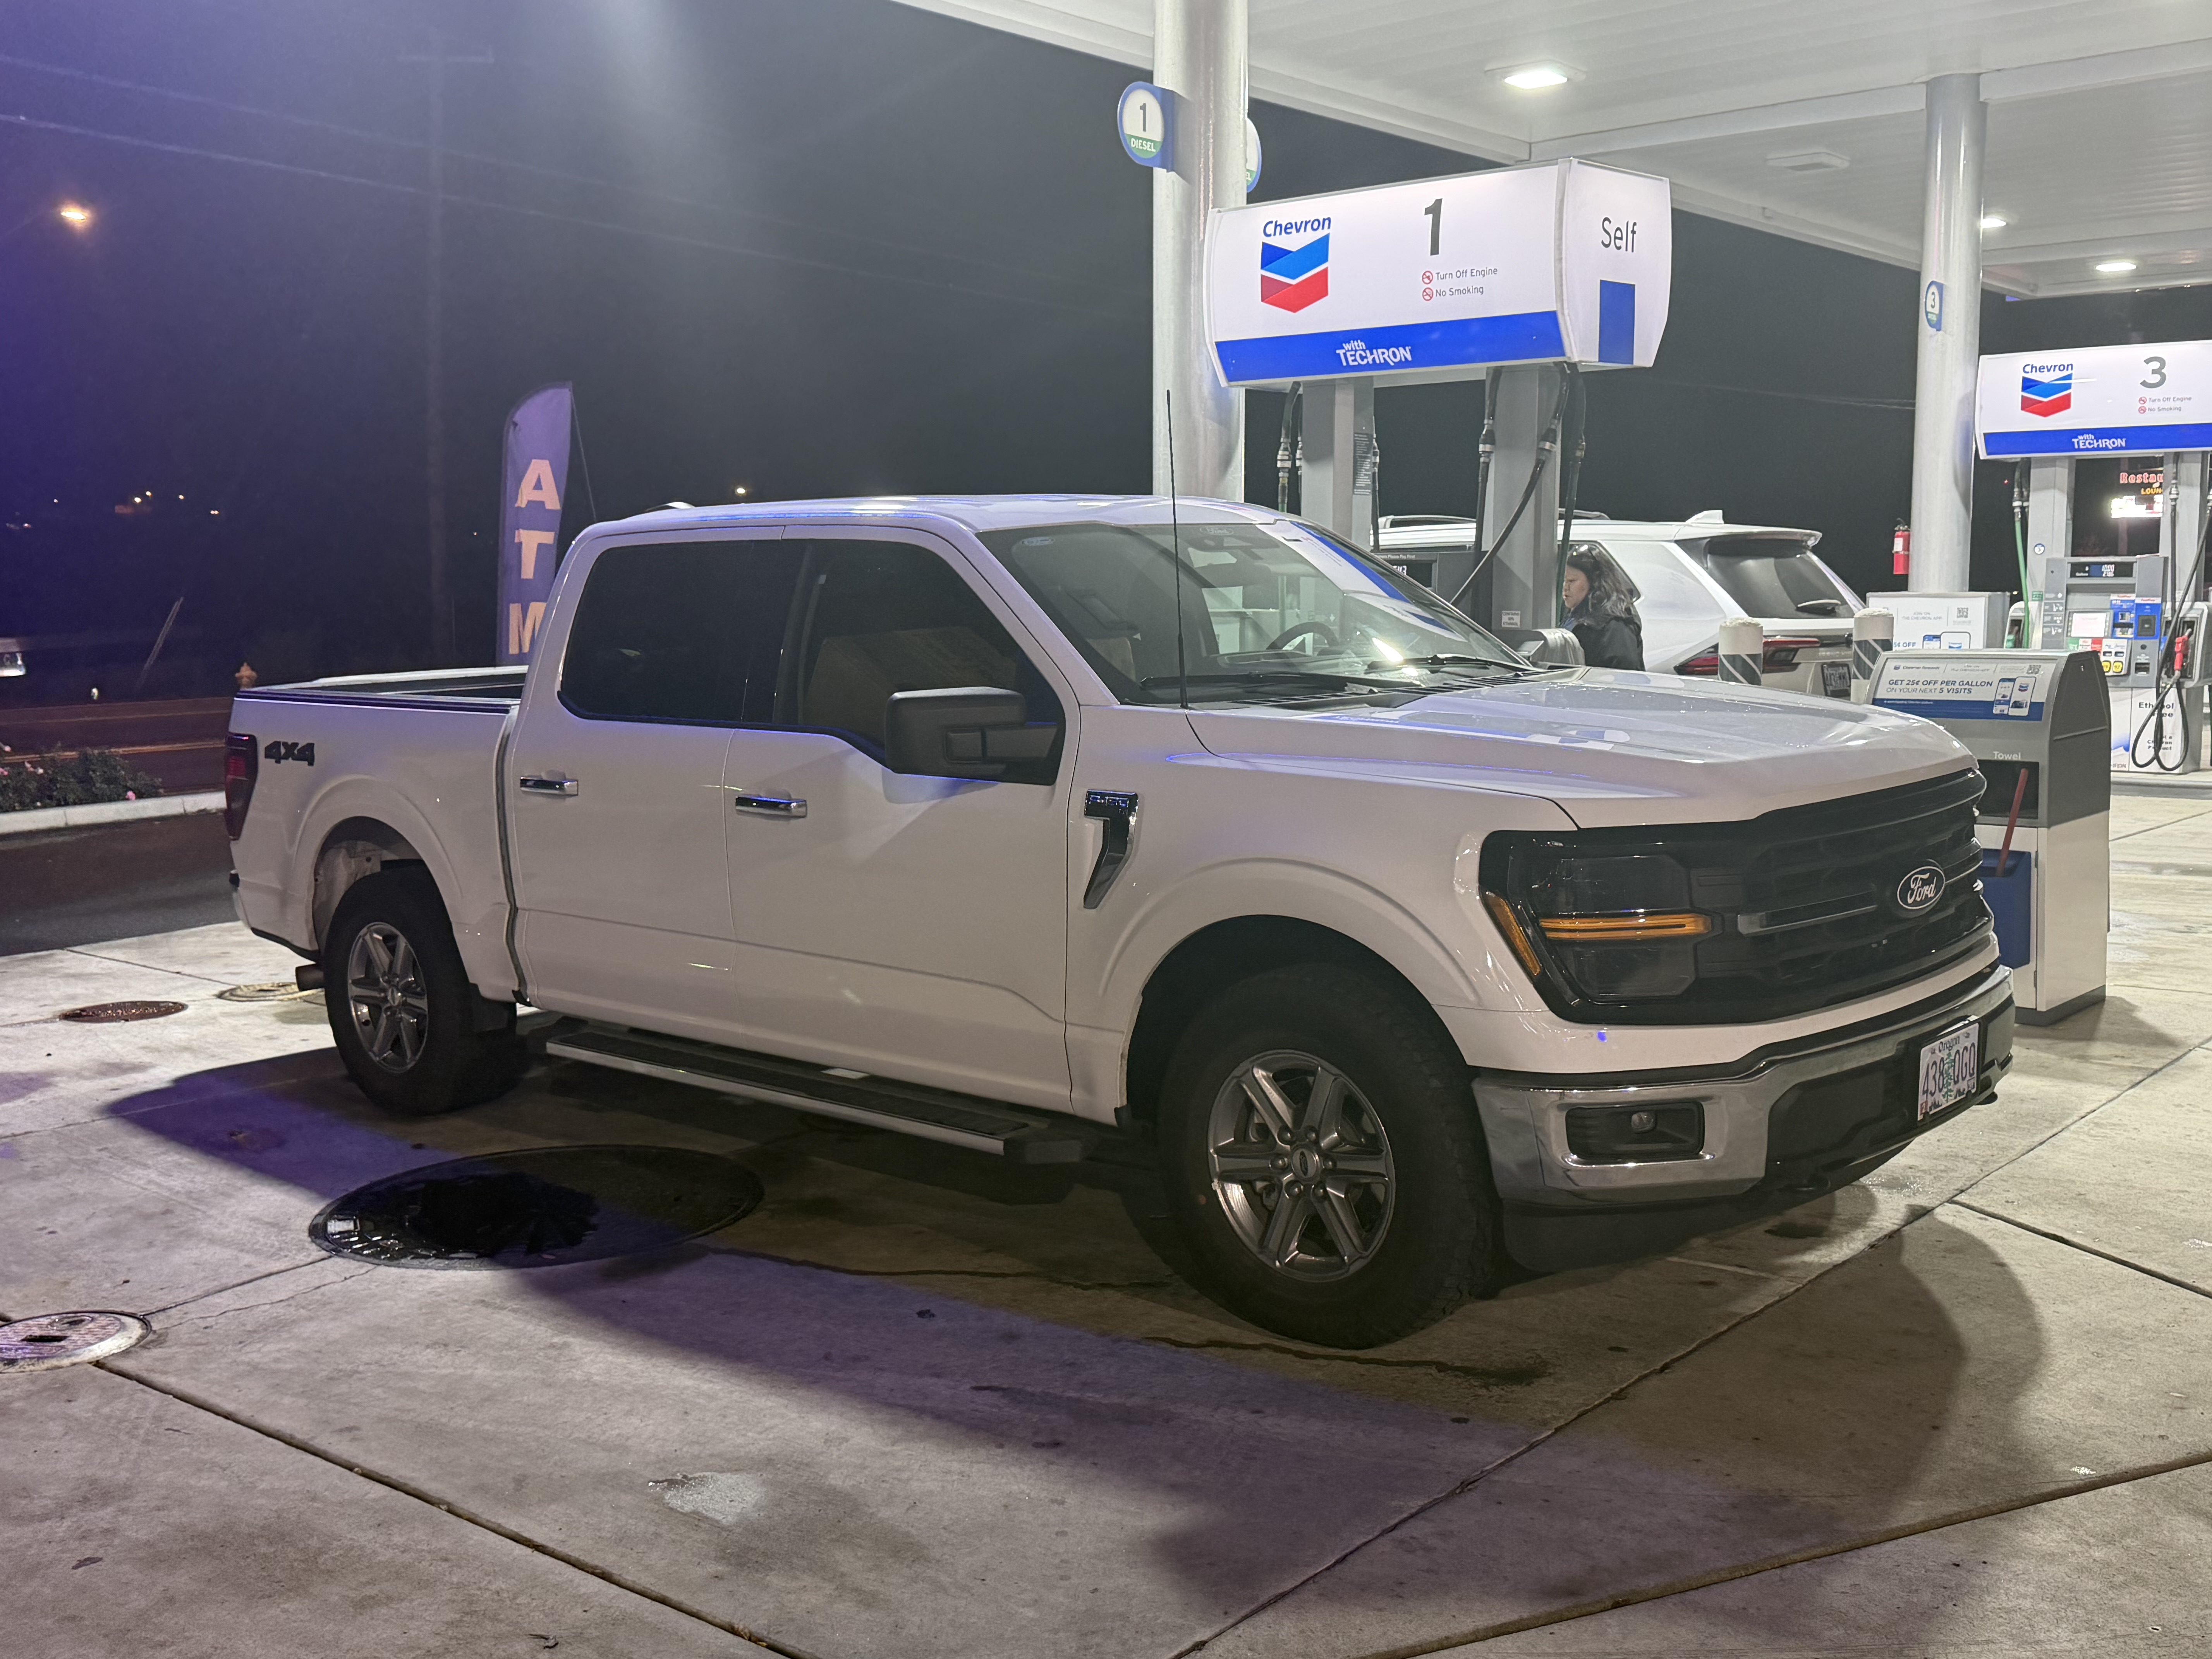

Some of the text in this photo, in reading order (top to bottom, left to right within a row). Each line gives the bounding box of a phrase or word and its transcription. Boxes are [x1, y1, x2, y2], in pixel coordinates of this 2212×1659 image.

[1139, 102, 1147, 132] 1
[1130, 138, 1156, 152] DIESEL
[1262, 216, 1331, 237] Chevron
[1424, 198, 1443, 256] 1
[1601, 216, 1637, 253] Self
[1436, 267, 1498, 281] Turn Off Engine
[1436, 285, 1484, 297] No Smoking
[1930, 291, 1936, 309] 3
[1342, 339, 1366, 351] with
[1336, 346, 1412, 366] TECHRON
[2022, 363, 2073, 374] Chevron
[2140, 356, 2167, 389] 3
[2072, 438, 2126, 449] TECHRON
[1993, 751, 2021, 760] Towel
[1907, 872, 1937, 904] Ford
[1938, 1036, 1960, 1053] Oregon
[1922, 1042, 1976, 1100] 438 QGQ
